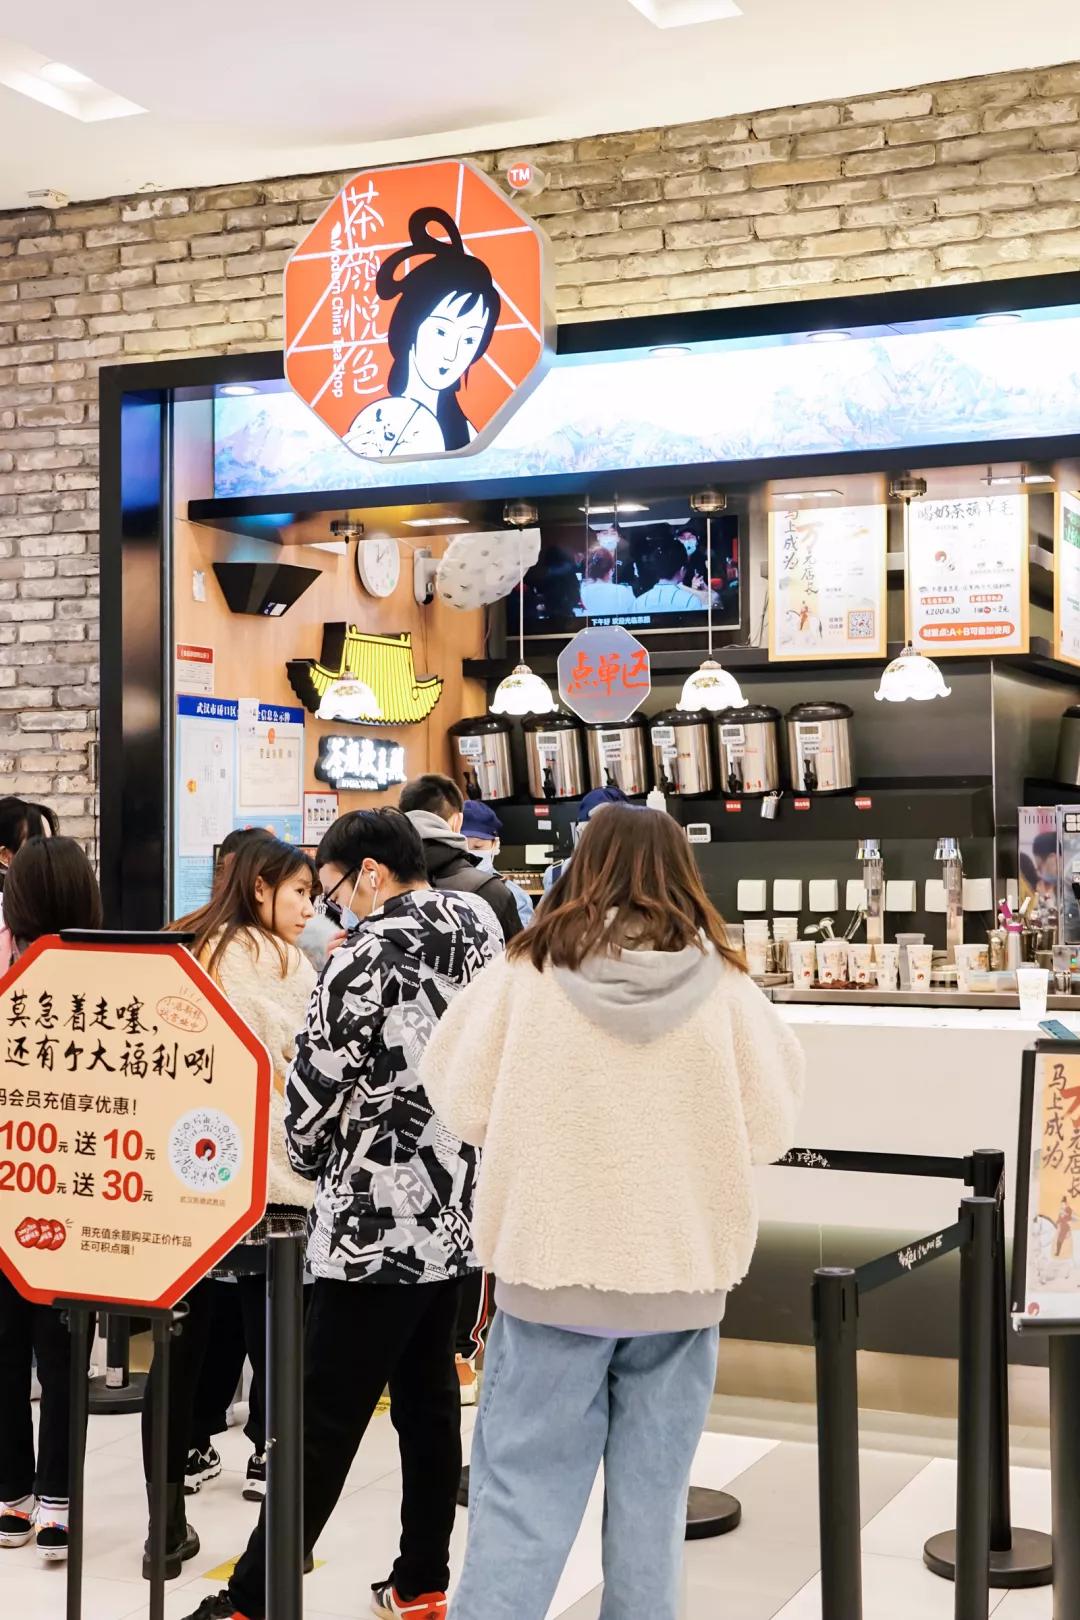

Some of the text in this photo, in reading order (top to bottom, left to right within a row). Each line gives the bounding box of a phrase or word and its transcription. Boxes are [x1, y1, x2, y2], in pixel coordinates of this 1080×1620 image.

[510, 167, 530, 181] TM
[332, 297, 344, 336] China
[567, 649, 649, 696] 点单区
[1042, 1063, 1067, 1169] 马上成为
[81, 1226, 192, 1247] 用充值余额购买正价作品
